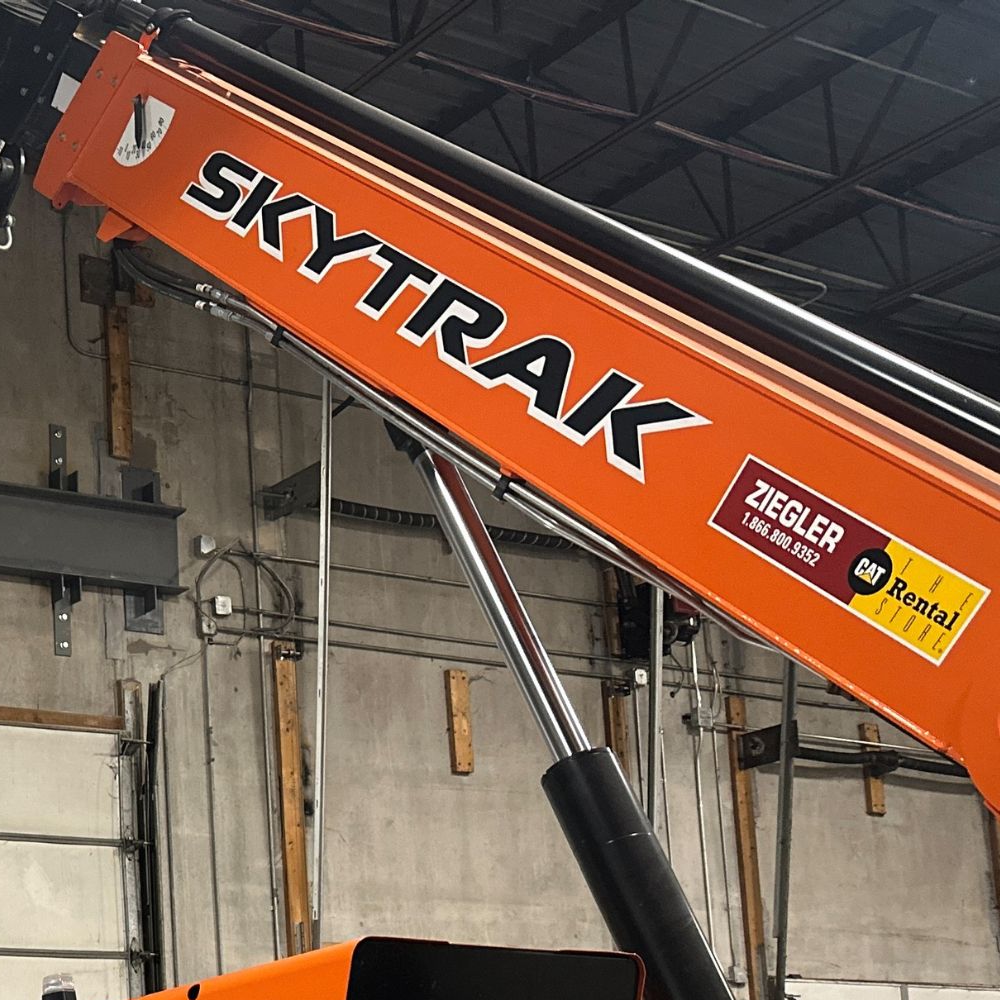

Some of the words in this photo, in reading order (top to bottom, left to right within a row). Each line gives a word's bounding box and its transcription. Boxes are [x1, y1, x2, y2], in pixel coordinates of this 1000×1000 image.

[181, 150, 712, 484] SKYTRAK
[741, 511, 821, 567] 1.866.800.9352
[744, 479, 845, 554] ZIEGLER
[854, 557, 886, 586] CAT
[885, 576, 960, 632] Rental
